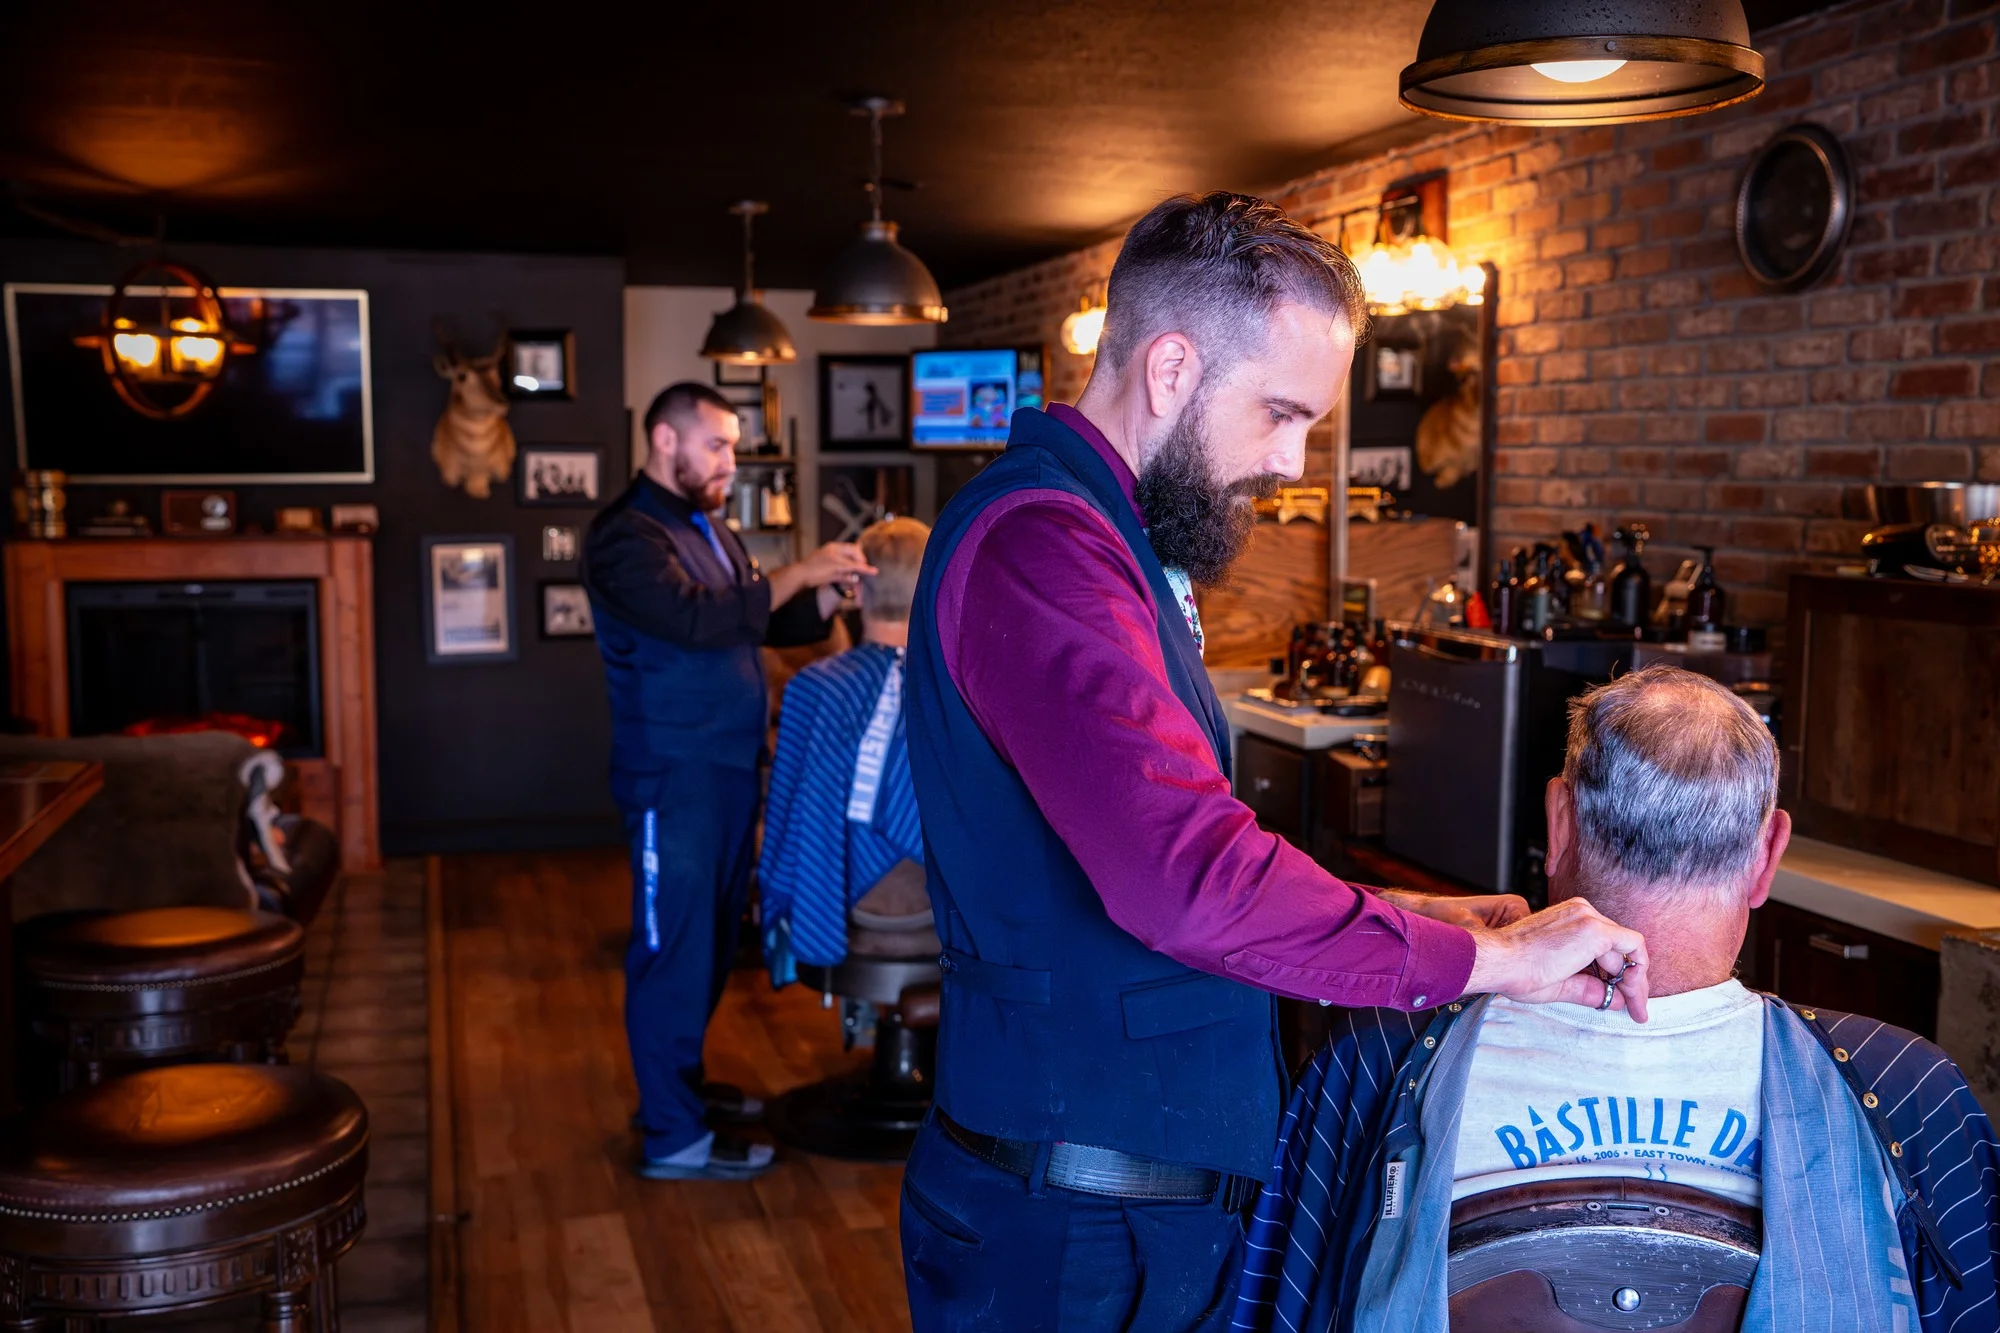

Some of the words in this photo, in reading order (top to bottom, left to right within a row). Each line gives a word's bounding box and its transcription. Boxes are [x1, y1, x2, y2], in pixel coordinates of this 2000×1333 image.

[1494, 1096, 1699, 1170] BASTILLE
[1593, 1149, 1620, 1161] 2006
[1634, 1149, 1665, 1159] EAST
[1667, 1151, 1706, 1166] TOWN
